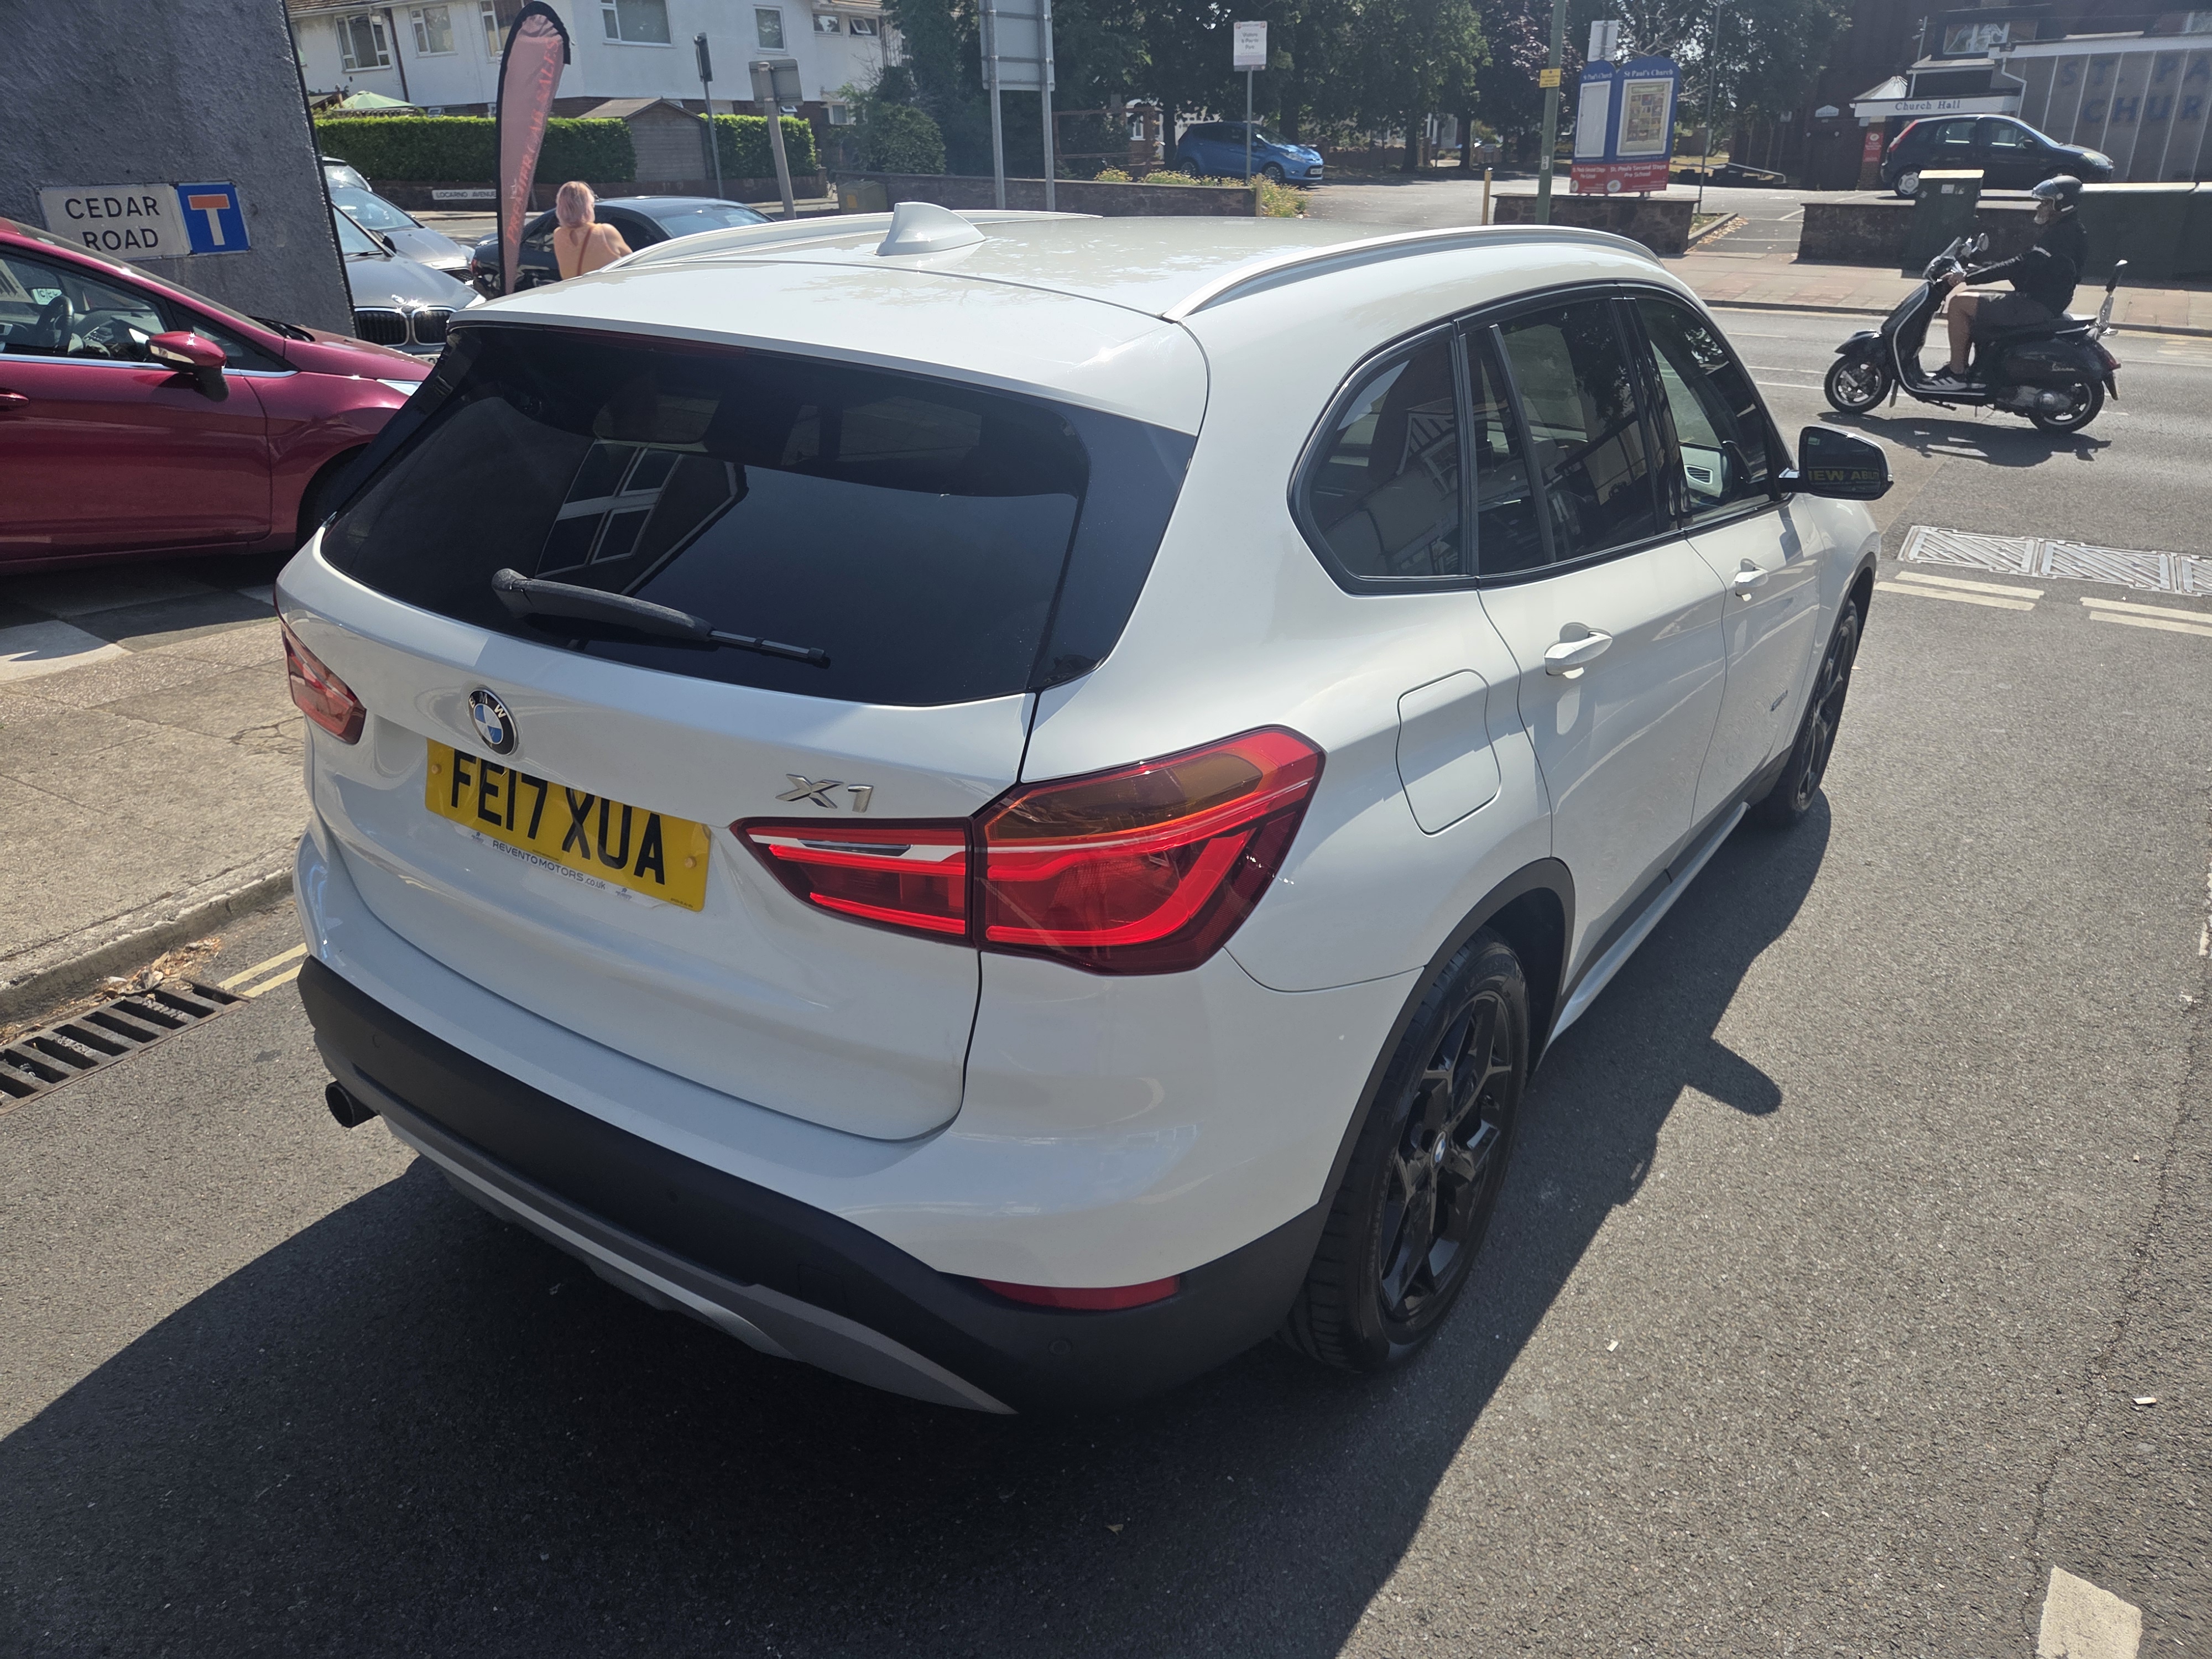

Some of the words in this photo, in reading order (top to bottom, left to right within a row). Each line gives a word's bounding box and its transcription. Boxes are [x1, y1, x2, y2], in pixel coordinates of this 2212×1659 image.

[1895, 102, 1932, 111] Church
[1938, 100, 1960, 109] Hall
[65, 196, 160, 219] CEDAR
[82, 228, 158, 251] ROAD
[469, 691, 507, 718] BMW
[775, 774, 874, 813] X1
[451, 749, 547, 840] FE17
[561, 786, 665, 885] XUA
